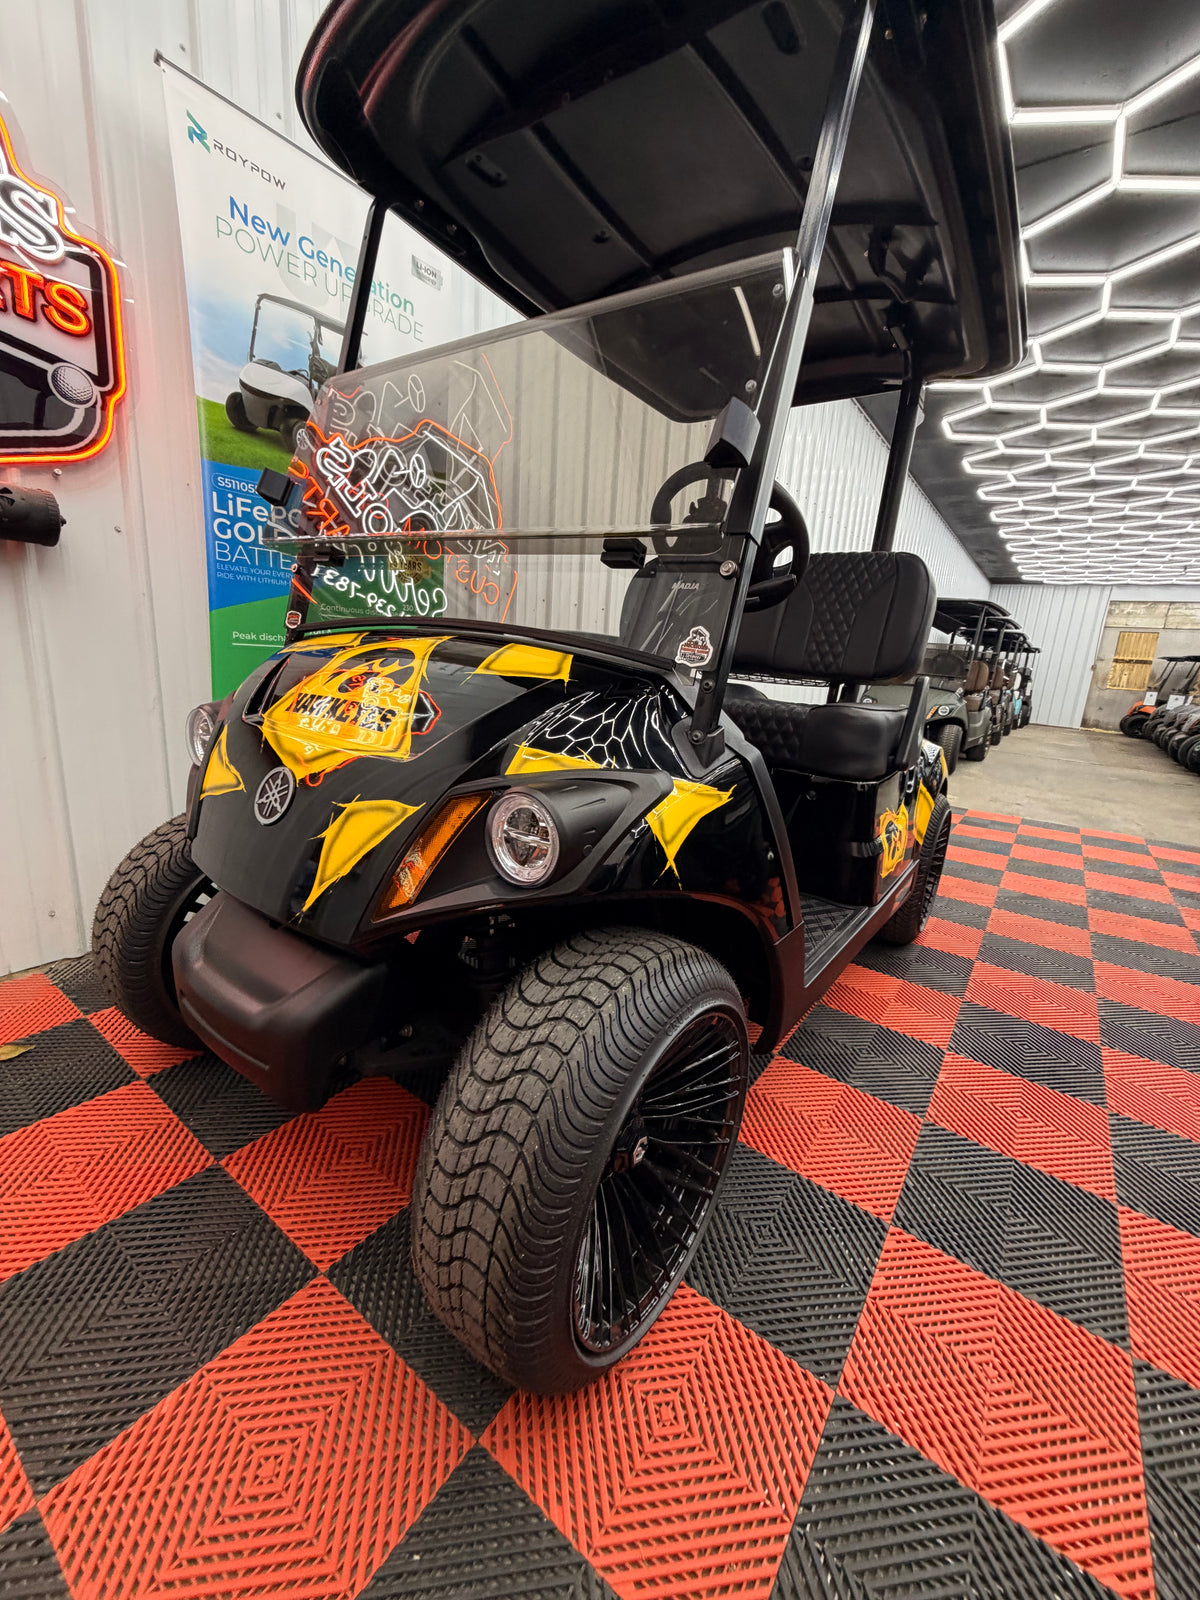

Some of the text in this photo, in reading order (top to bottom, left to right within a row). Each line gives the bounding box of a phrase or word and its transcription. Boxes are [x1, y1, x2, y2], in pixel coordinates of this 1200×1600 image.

[213, 138, 286, 190] ROYPOW
[216, 215, 317, 287] POWER
[229, 195, 415, 316] New Geneation
[216, 541, 297, 571] BATTE
[216, 572, 291, 586] RIDE WITH LITHIUM-
[217, 563, 248, 574] ELEVATE
[250, 567, 271, 577] YOUR
[320, 603, 364, 614] Continuous
[232, 631, 257, 640] Peak
